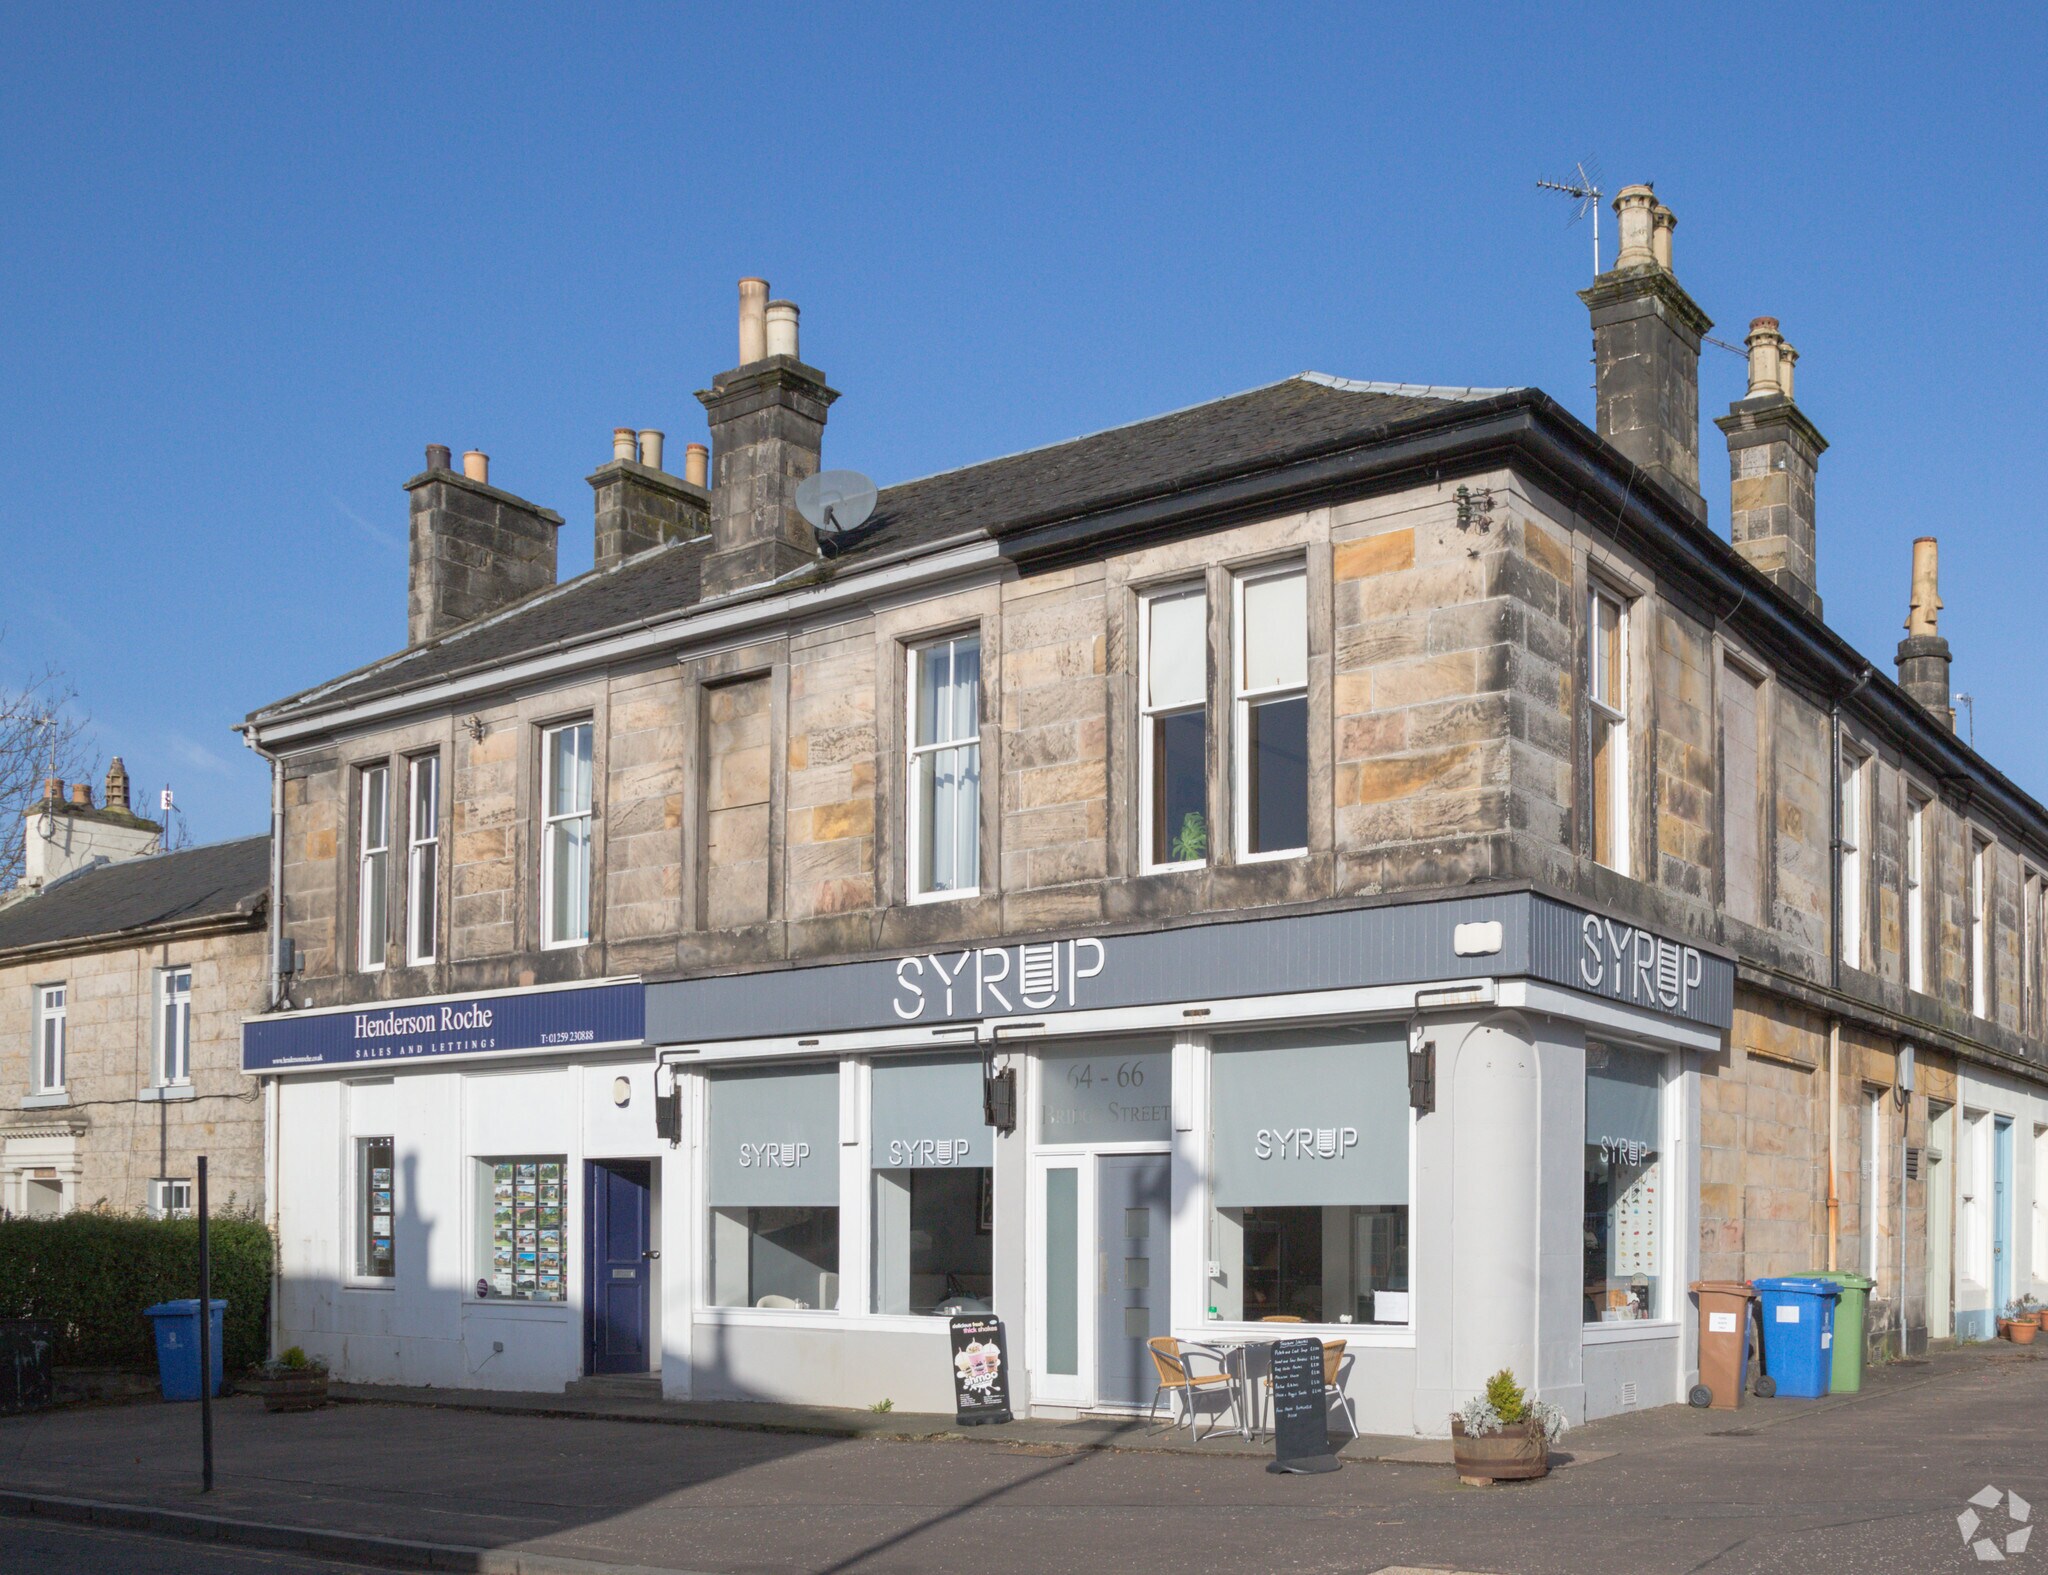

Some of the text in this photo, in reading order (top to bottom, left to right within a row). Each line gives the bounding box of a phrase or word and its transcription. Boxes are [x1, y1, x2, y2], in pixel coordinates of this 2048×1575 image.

[1580, 913, 1702, 1012] SYRUP
[893, 937, 1105, 1020] SYRUP
[354, 1002, 493, 1039] Henderson Roche
[355, 1038, 496, 1059] SALES AND LETTINGS
[1066, 1063, 1093, 1089] 64
[1116, 1060, 1144, 1088] 66
[738, 1142, 810, 1167] SYRUP
[888, 1138, 970, 1166] SYRUP
[1254, 1127, 1358, 1159] SYRUP
[1599, 1135, 1648, 1168] SYRUP
[964, 1371, 999, 1387] shmoo
